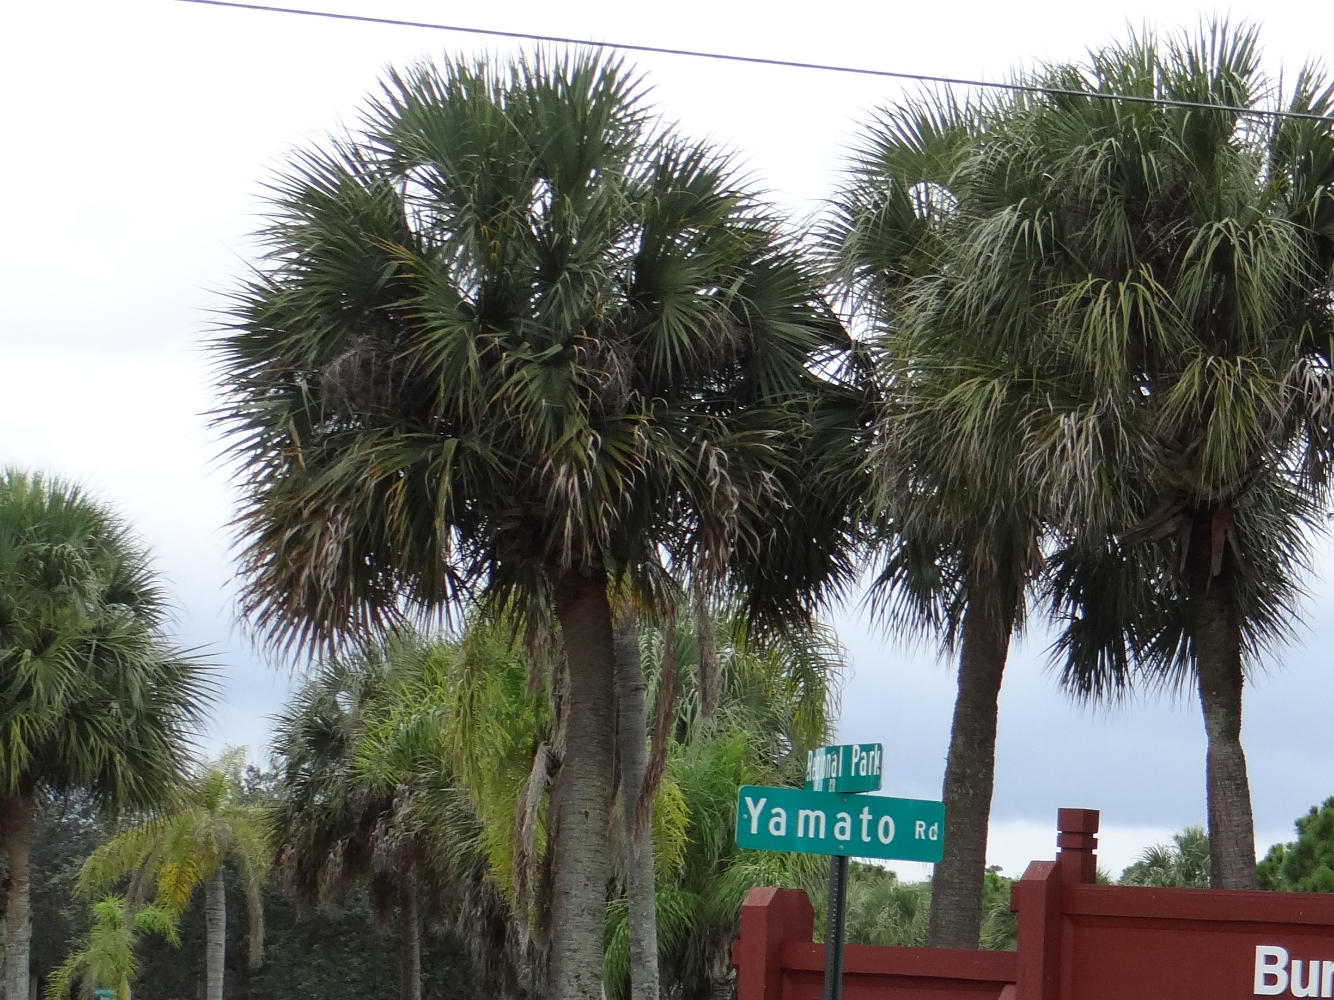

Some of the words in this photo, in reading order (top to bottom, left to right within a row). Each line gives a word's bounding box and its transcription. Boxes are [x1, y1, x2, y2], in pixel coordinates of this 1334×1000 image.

[851, 744, 880, 777] Park
[744, 796, 896, 844] Yamato
[914, 820, 939, 841] Rd
